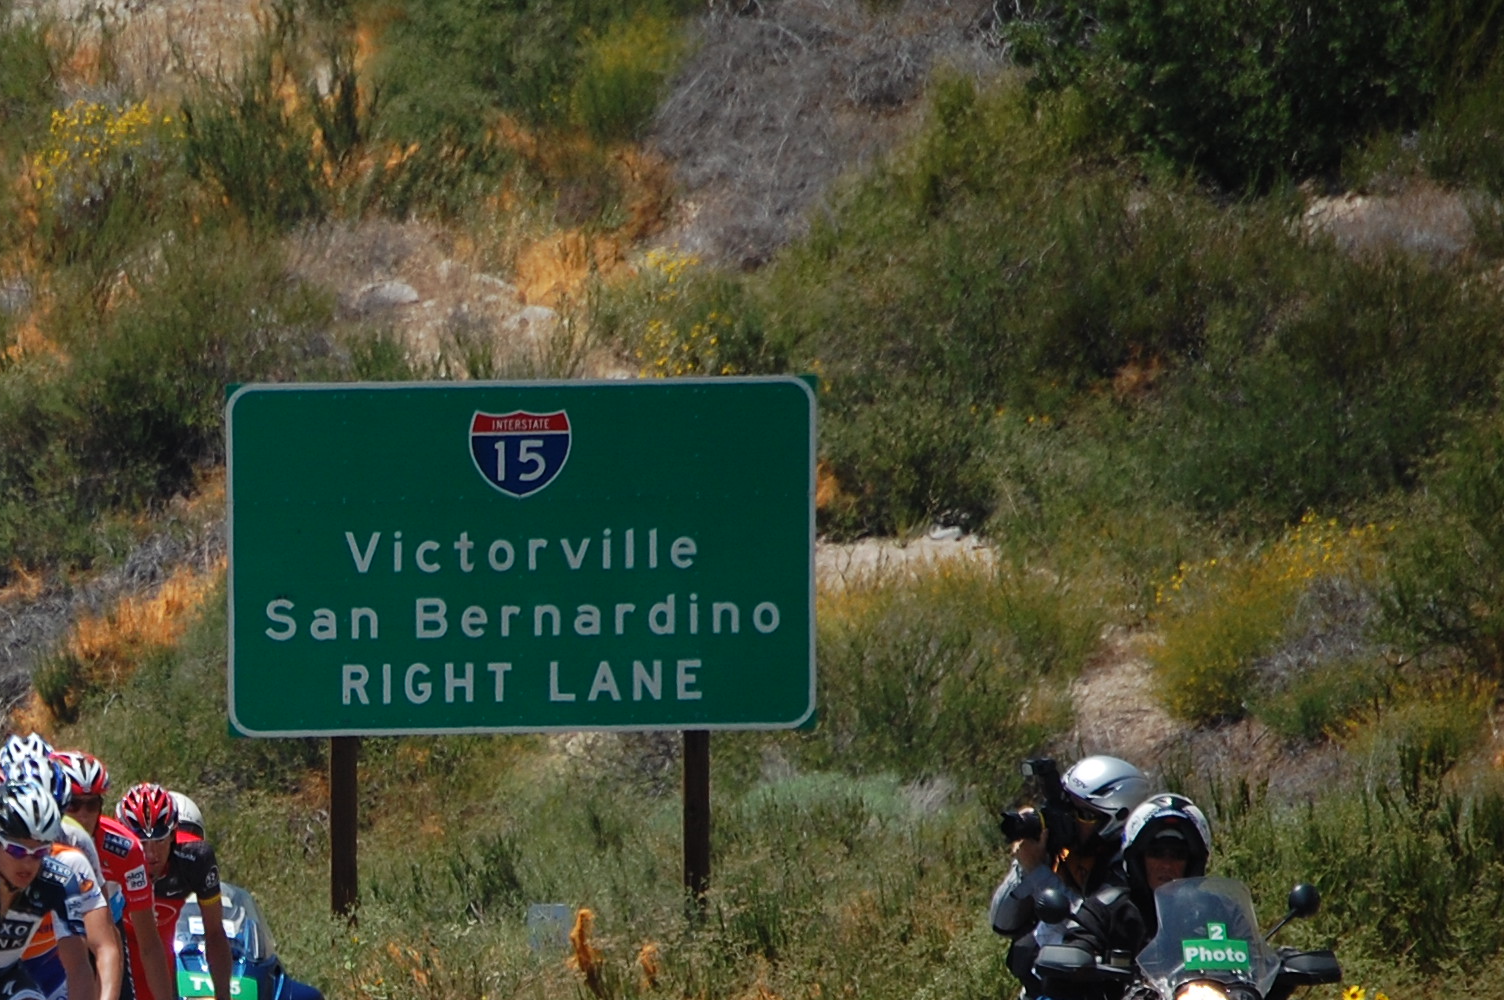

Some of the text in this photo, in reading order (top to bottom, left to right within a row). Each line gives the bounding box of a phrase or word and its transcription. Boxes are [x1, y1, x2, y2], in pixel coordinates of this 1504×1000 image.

[491, 418, 551, 431] INTERSTATE
[494, 439, 546, 482] 15
[345, 527, 698, 573] Victorville
[265, 593, 781, 641] San Bernardino
[342, 658, 703, 705] RIGHT LANE
[1210, 925, 1224, 940] 2
[1185, 946, 1246, 963] Photo
